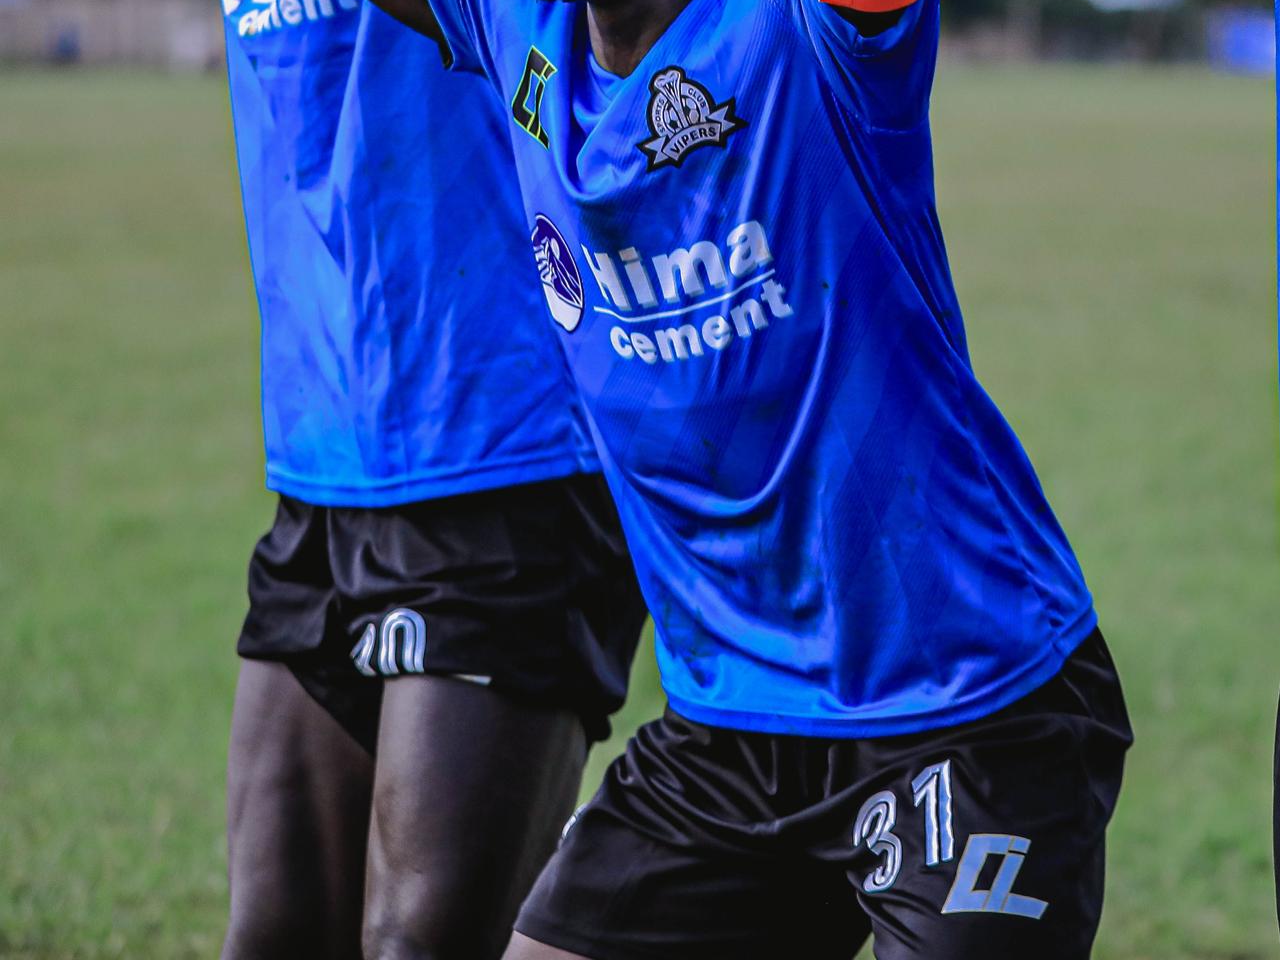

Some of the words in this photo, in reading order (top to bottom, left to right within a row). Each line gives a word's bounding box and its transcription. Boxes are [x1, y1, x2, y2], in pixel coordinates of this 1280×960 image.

[655, 98, 665, 133] SPORTS
[687, 87, 707, 109] CLUB
[670, 127, 716, 154] VIPERS
[580, 220, 776, 312] Hima
[609, 278, 795, 365] cement
[852, 759, 955, 894] 31
